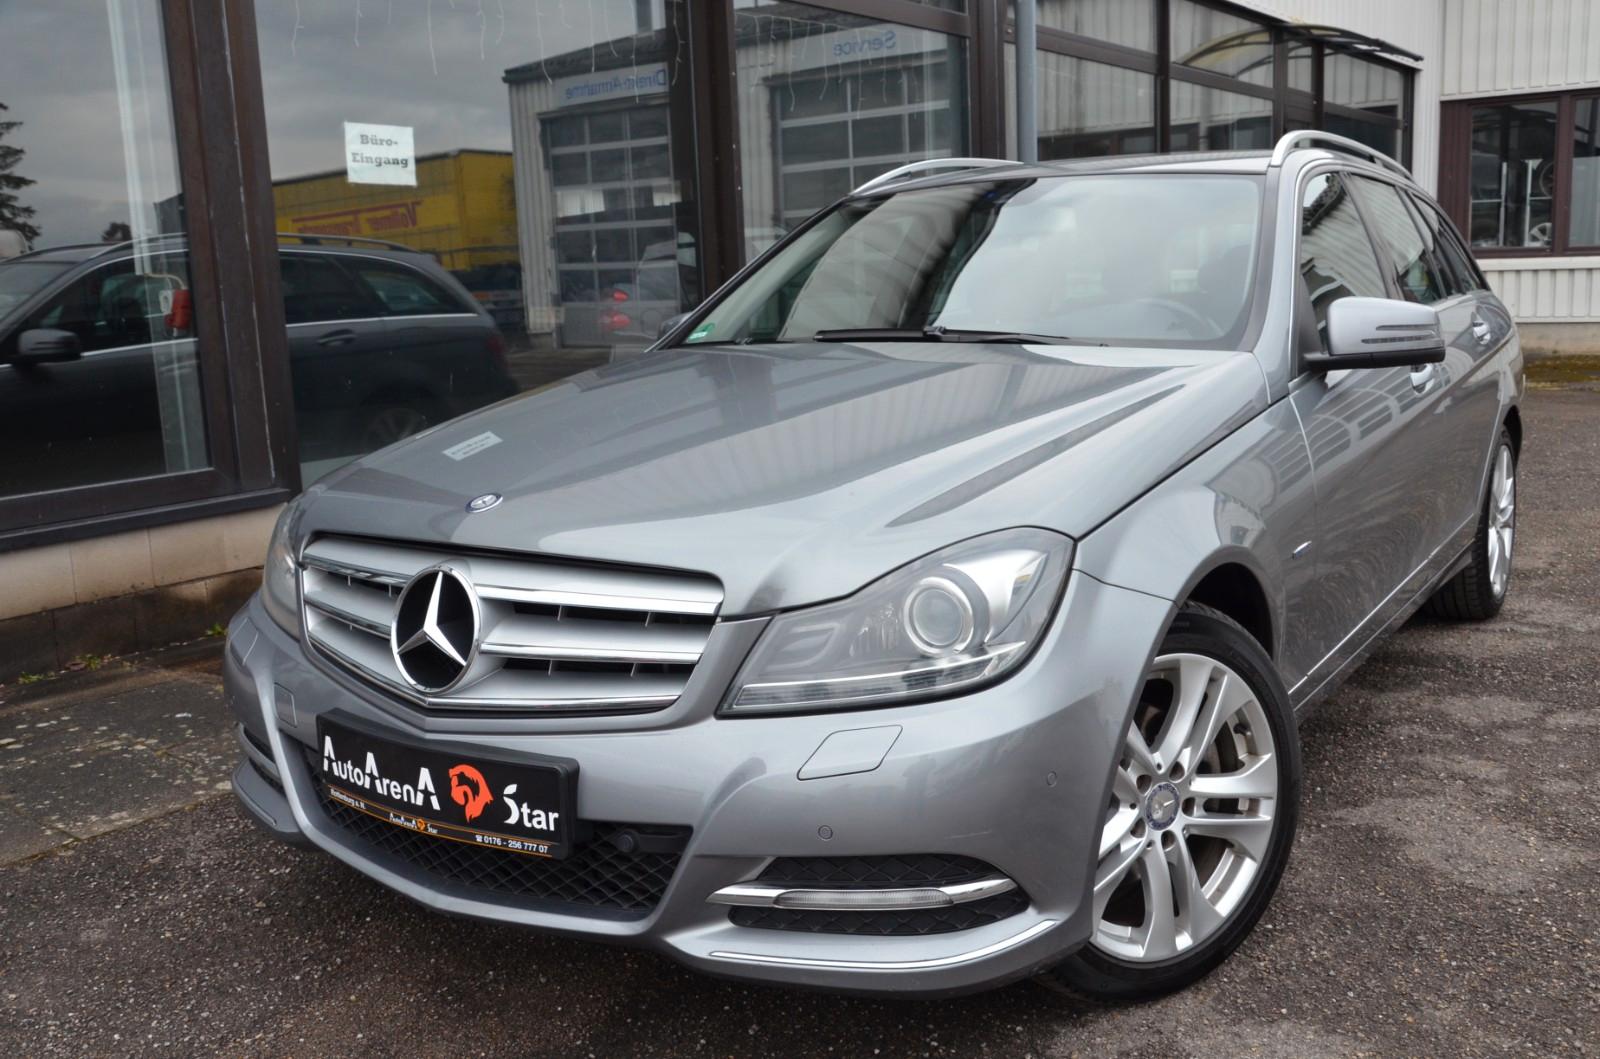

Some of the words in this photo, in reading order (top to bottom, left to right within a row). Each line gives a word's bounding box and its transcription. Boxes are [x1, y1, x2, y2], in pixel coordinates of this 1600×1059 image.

[360, 134, 398, 146] Büro-
[352, 152, 409, 168] Eingang
[503, 783, 560, 831] Star
[484, 837, 502, 846] 0176
[508, 840, 522, 849] 256
[523, 842, 537, 852] 777
[538, 844, 548, 853] 07
